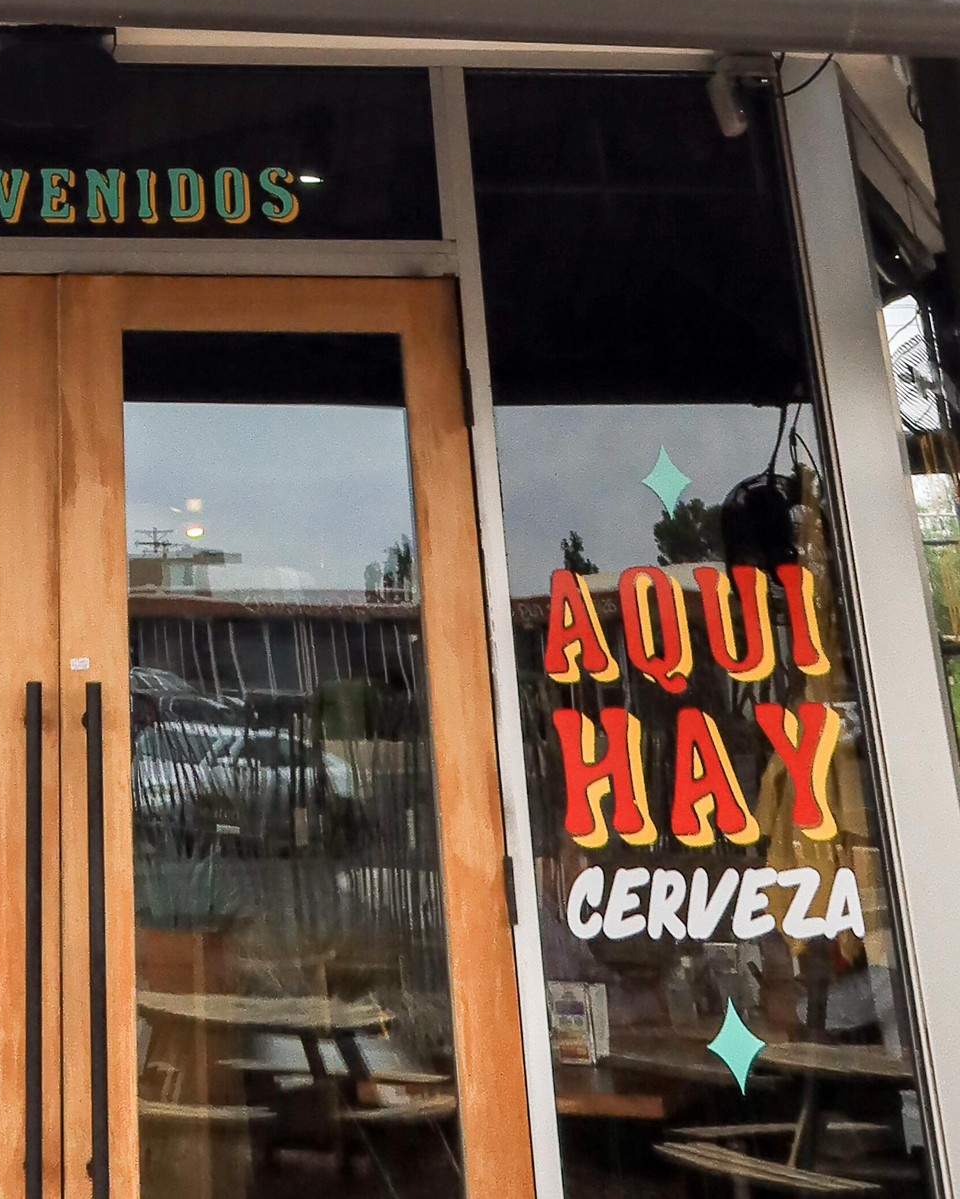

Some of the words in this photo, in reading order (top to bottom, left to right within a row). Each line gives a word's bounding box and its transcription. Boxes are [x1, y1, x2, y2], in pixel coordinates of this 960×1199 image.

[545, 566, 832, 693] AQUI
[552, 703, 840, 848] HAY
[567, 867, 866, 940] CERVEZA
